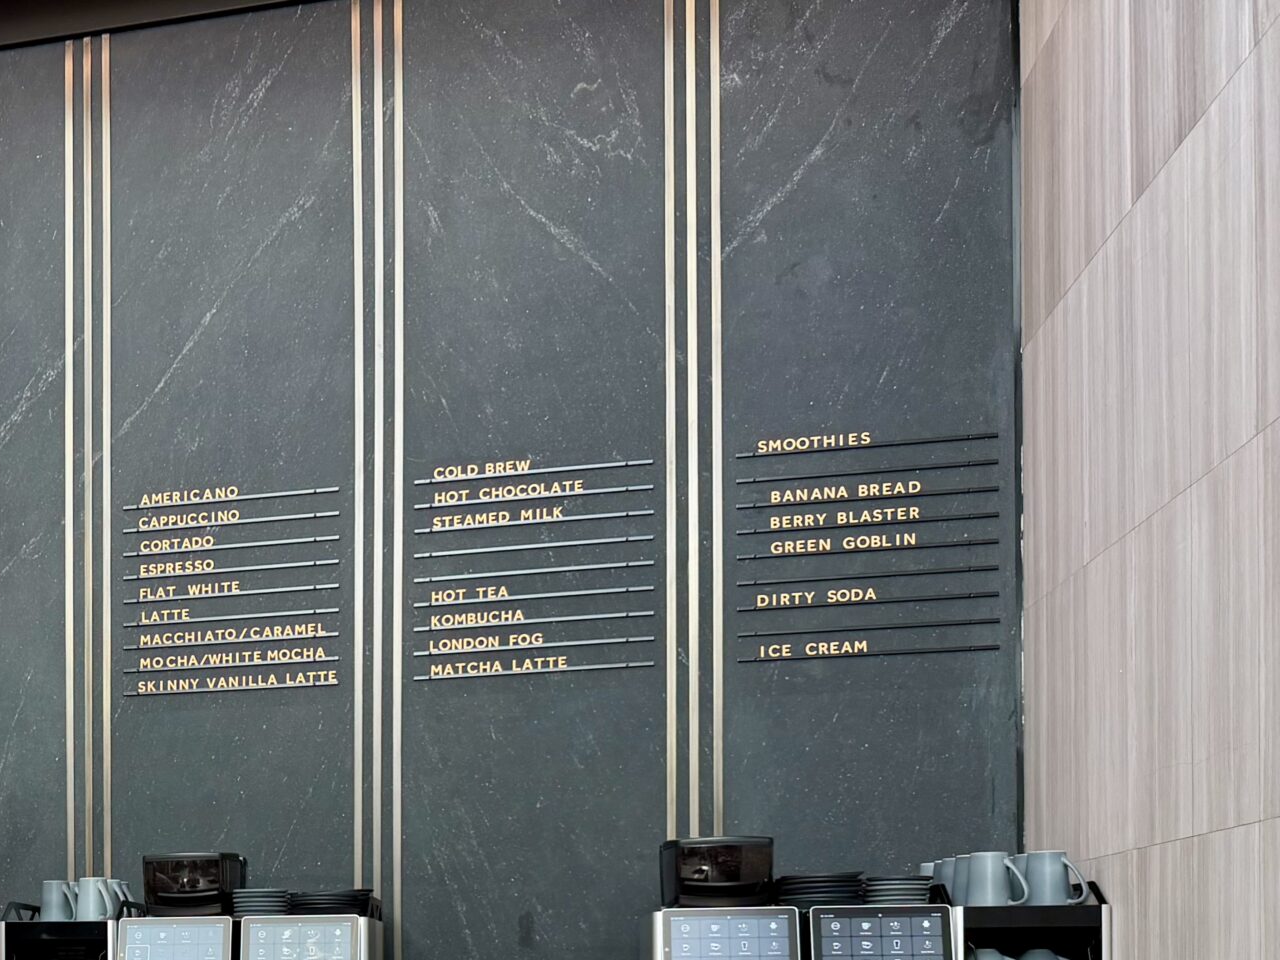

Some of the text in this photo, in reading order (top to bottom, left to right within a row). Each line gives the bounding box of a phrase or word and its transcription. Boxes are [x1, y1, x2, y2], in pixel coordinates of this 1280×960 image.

[758, 432, 871, 453] SMOOTHIES
[434, 459, 530, 480] COLD BREW
[141, 487, 239, 505] AMERICANO
[434, 480, 583, 505] HOT CHOCOLATE
[771, 480, 921, 503] BANANA BREAD
[139, 510, 240, 529] CAPPUCCINO
[433, 506, 564, 530] STEAMED MILK
[770, 507, 920, 529] BERRY BLASTER
[141, 536, 214, 553] CORTADO
[771, 533, 916, 554] GREEN GOBLIN
[140, 559, 214, 576] ESPRESSO
[140, 581, 240, 600] FLAT WHITE
[431, 585, 509, 603] HOT TEA
[757, 588, 876, 607] DIRTY SODA
[141, 608, 190, 623] LATTE
[431, 608, 524, 627] KOMBUCHA
[140, 622, 326, 646] MACCHIATO/CARAMEL
[430, 632, 543, 653] LONDON FOG
[140, 645, 325, 669] MOCHA/WHITE MOCHA
[760, 640, 868, 658] ICE CREAM
[430, 655, 568, 676] MATCHA LATTE
[138, 669, 337, 693] SKINNY VANILLA LATTE
